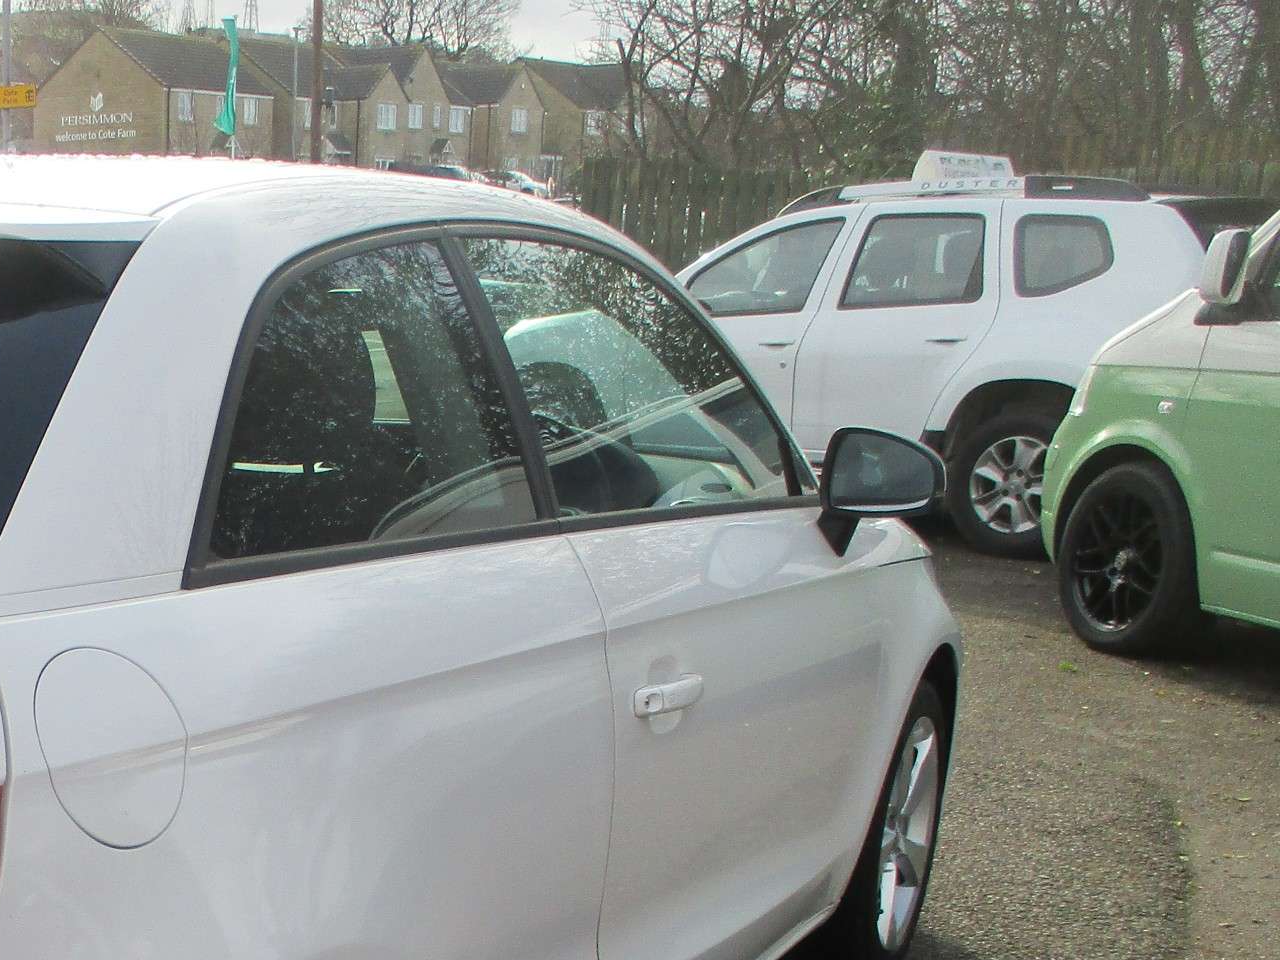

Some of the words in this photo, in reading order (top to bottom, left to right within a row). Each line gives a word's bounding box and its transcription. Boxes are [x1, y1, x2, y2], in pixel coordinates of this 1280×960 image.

[61, 112, 133, 126] PERSIMMON
[56, 132, 87, 142] welcome
[88, 131, 97, 140] to
[117, 128, 137, 138] Farm
[921, 179, 1018, 190] DUSTER
